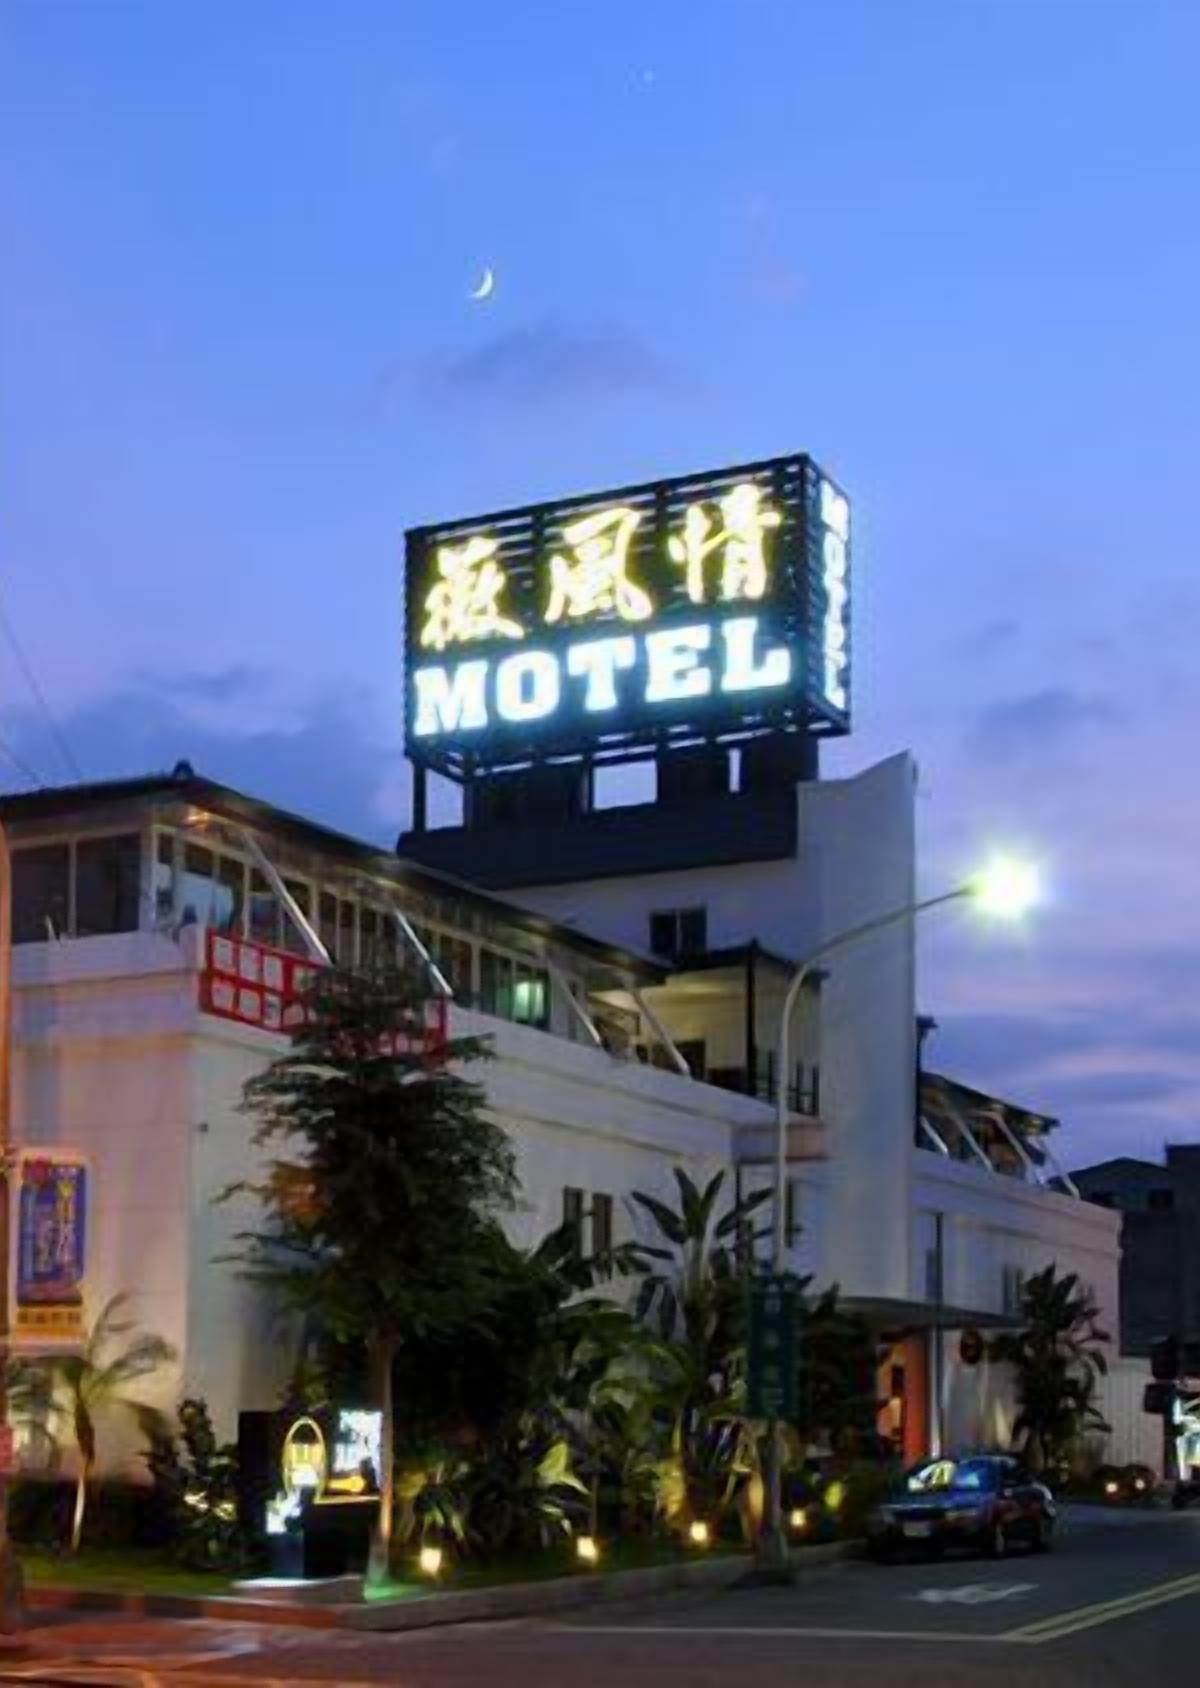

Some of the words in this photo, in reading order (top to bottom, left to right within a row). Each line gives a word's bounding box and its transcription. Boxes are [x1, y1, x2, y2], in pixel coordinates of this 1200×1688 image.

[419, 482, 783, 650] 薇風情
[411, 615, 793, 737] MOTEL
